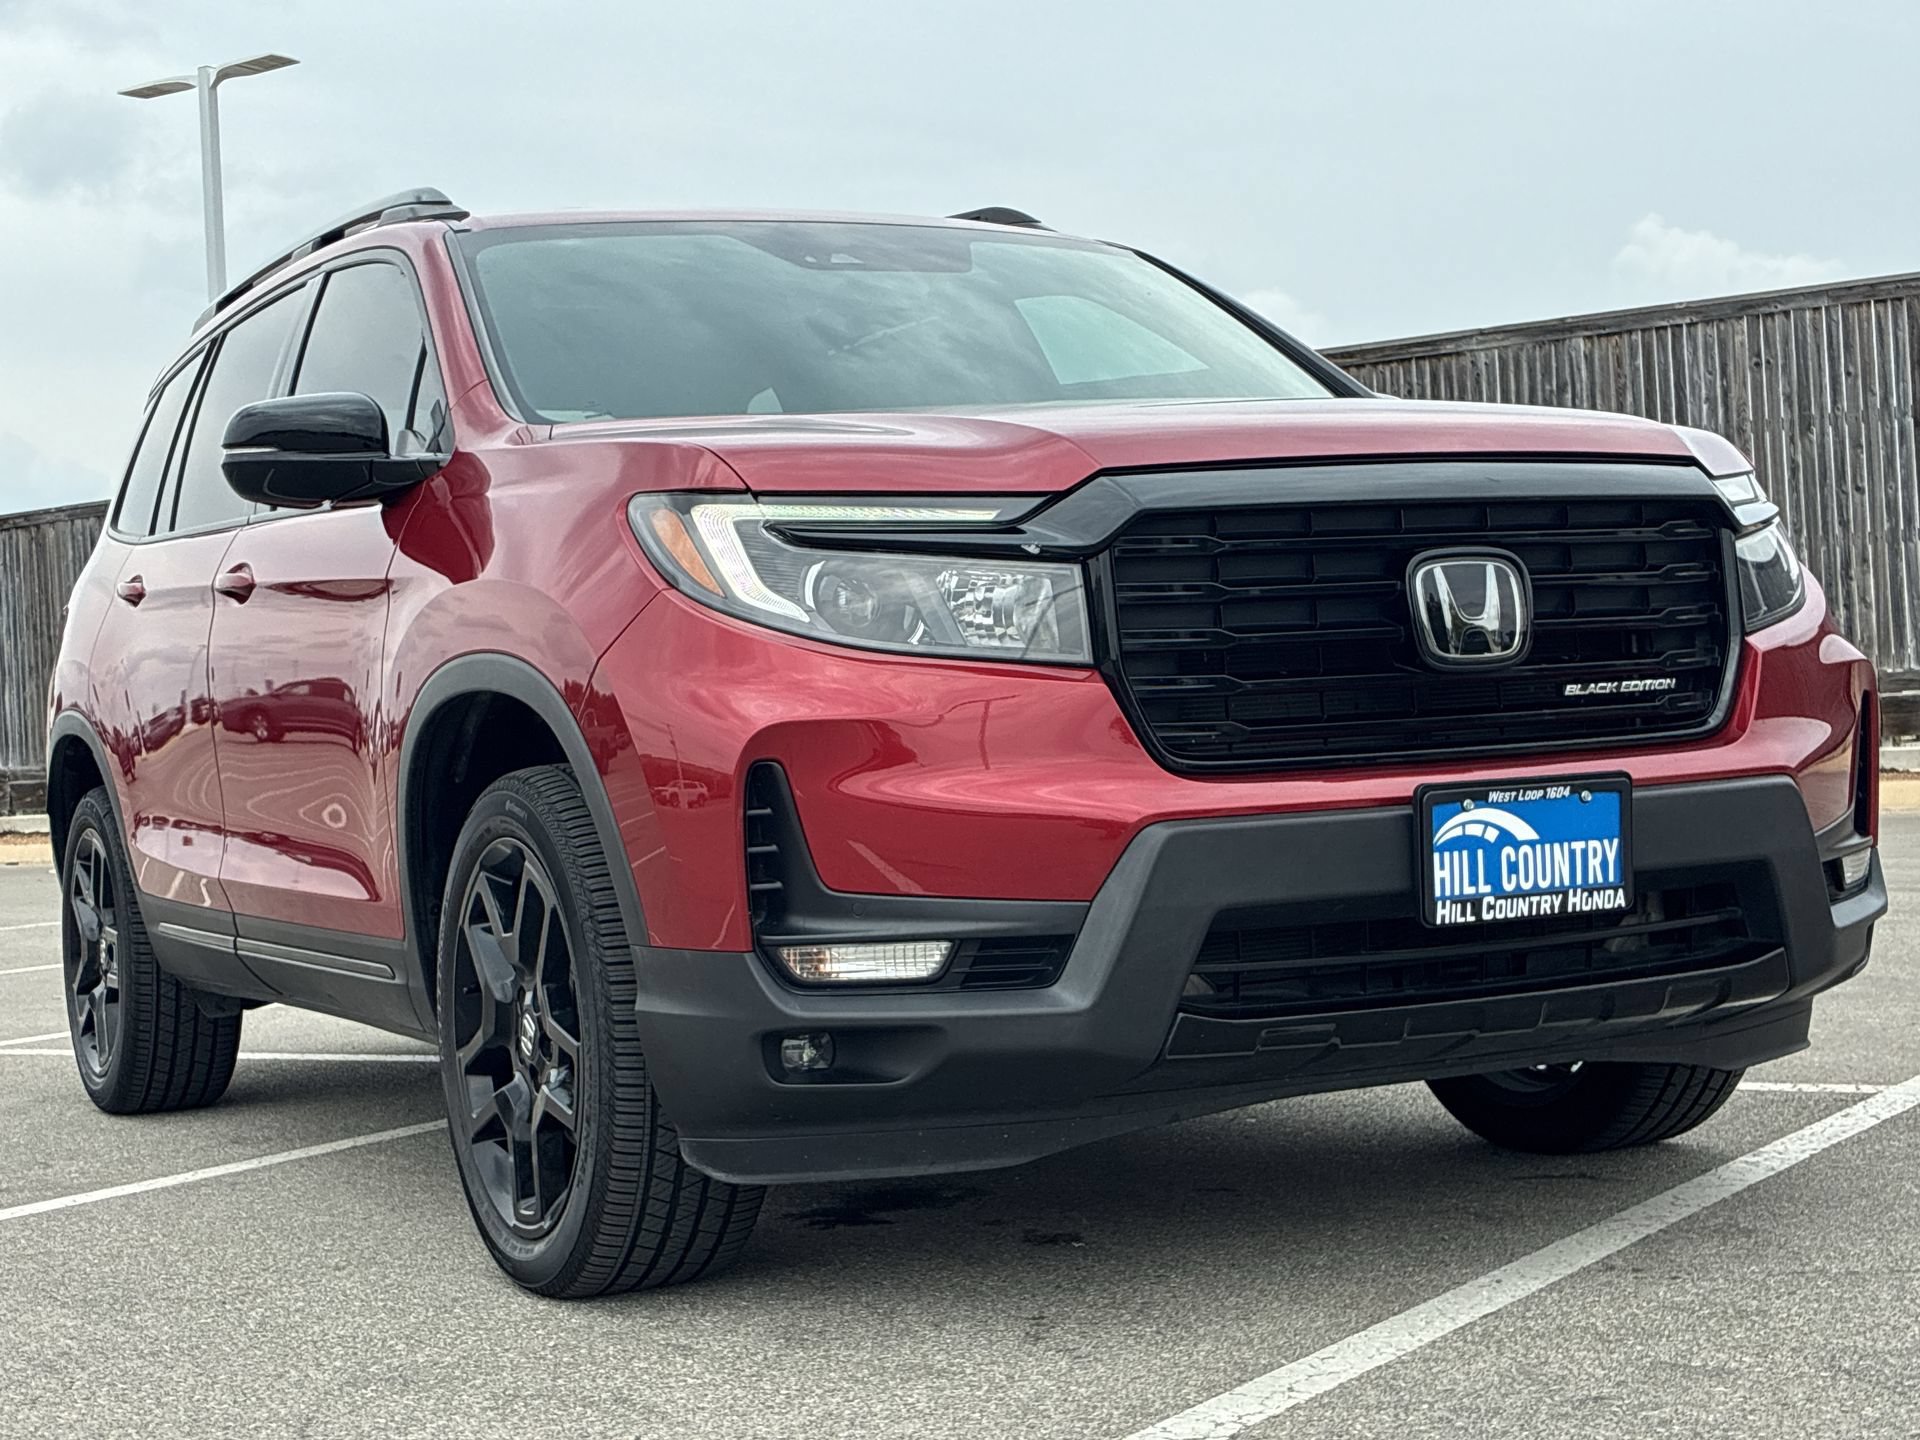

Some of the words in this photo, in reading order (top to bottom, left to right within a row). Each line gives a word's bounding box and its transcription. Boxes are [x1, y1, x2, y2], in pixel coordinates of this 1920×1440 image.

[1564, 681, 1618, 696] BLACK
[1620, 678, 1676, 692] EDITION
[1488, 790, 1517, 803] WEST
[1518, 788, 1544, 801] LOOP
[1546, 785, 1571, 799] 1604
[1433, 848, 1491, 897] HILL
[1501, 838, 1619, 891] COUNTRY
[1436, 900, 1476, 925] HILL
[1481, 893, 1563, 920] COUNTRY
[1567, 888, 1626, 913] HONDA
